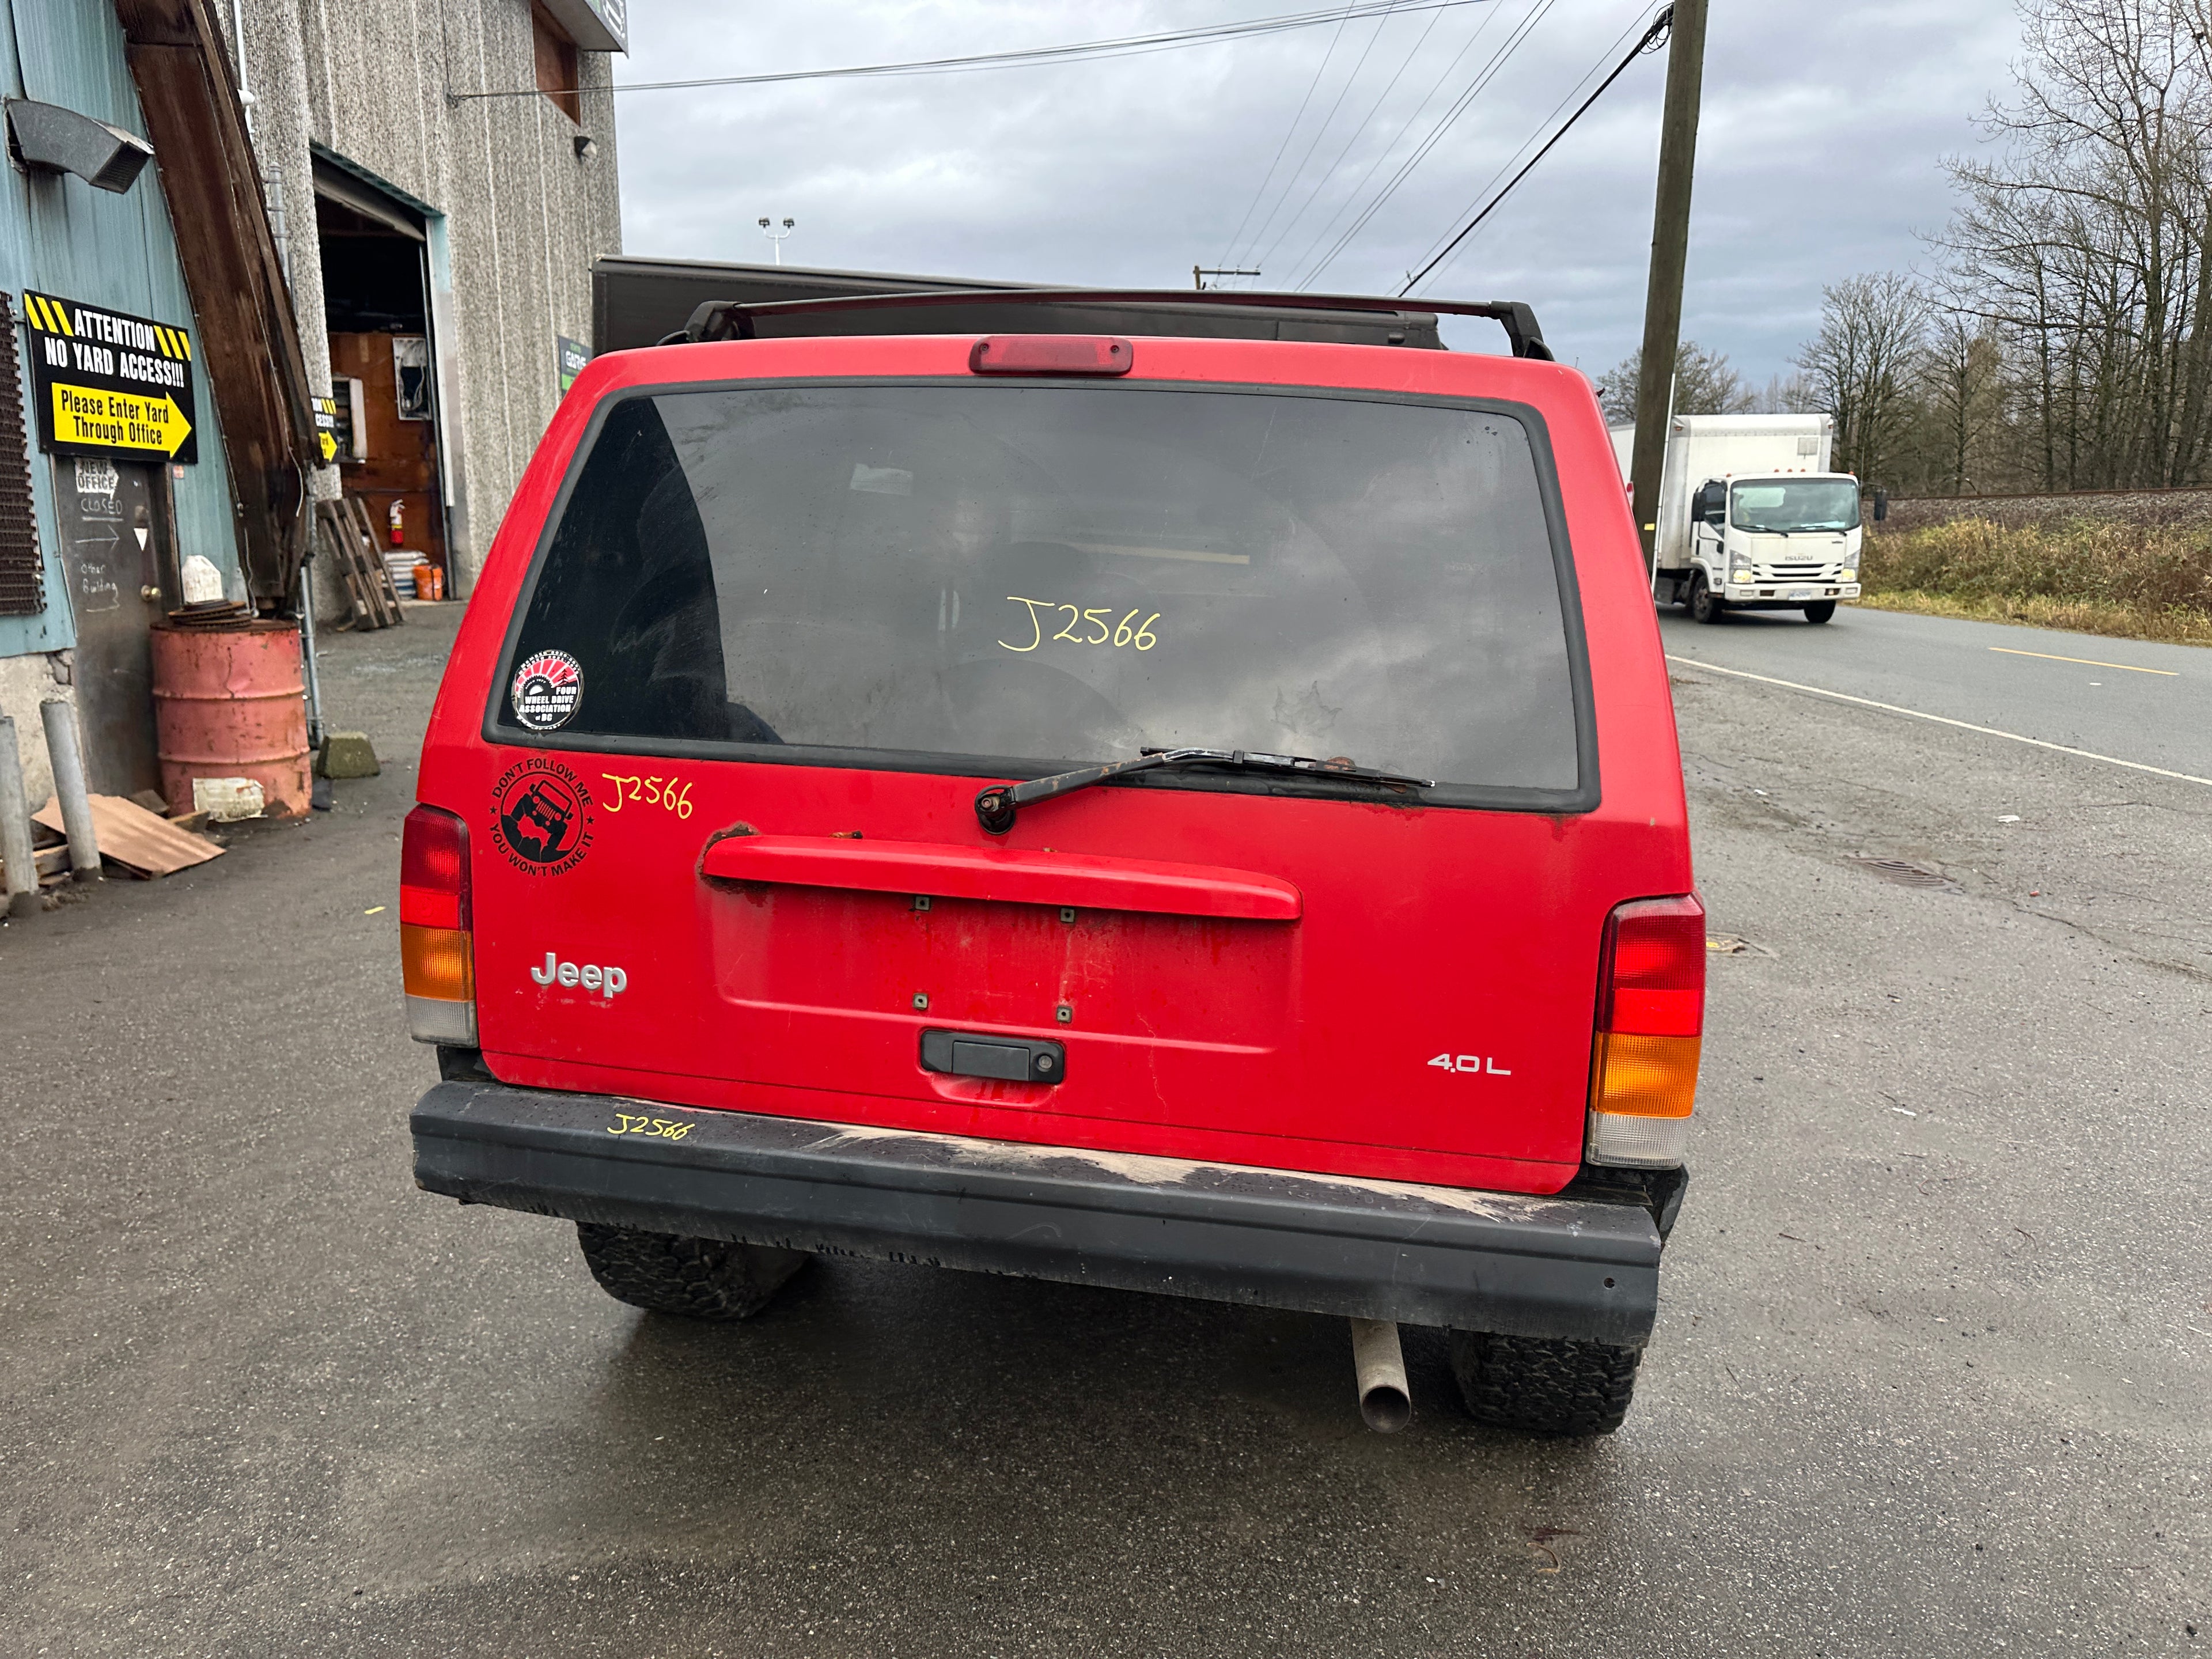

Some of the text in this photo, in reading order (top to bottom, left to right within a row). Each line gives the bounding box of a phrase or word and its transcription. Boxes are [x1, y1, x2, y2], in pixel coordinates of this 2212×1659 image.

[74, 309, 156, 351] ATTENTION
[44, 337, 184, 388] NO YARD ACCESS!!!
[61, 389, 169, 424] Please Enter Yard
[73, 416, 162, 445] Through Office
[78, 475, 116, 490] OFFICE
[81, 498, 122, 514] CLOSED
[998, 596, 1161, 652] J2566
[525, 695, 574, 704] WHEEL DRIVE
[556, 686, 577, 695] FOUR
[519, 704, 571, 713] ASSOCIATION
[491, 758, 593, 808] DON'T FOLLOW ME
[602, 773, 693, 819] J2566
[490, 823, 594, 877] YOU WON'T MAKE IT
[531, 952, 627, 998] Jeep
[607, 1113, 695, 1141] J2566
